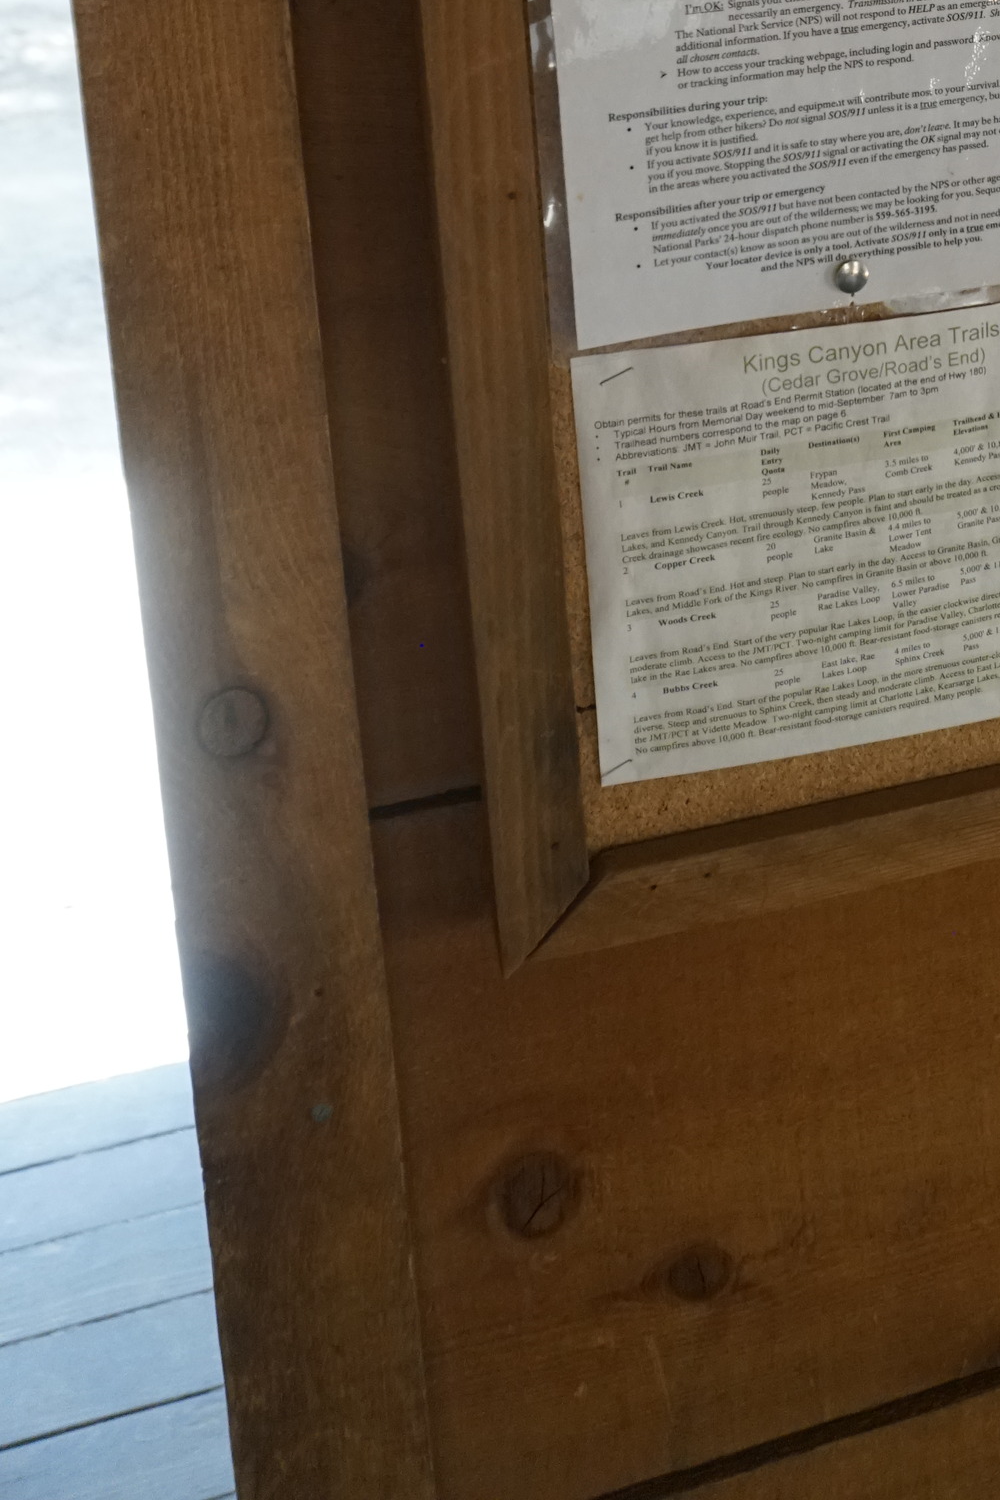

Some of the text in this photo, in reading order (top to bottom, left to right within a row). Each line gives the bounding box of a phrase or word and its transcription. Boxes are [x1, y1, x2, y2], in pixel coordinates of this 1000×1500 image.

[608, 95, 768, 122] Responsibilities during your trip:
[615, 185, 826, 222] Responsibilities after your trip or emergency
[744, 321, 1000, 374] Kings Canyon Area Trails
[762, 347, 986, 397] (Cedar Grove/Road's End)
[650, 490, 704, 504] Lewis Creek
[658, 612, 717, 628] Woods Creek
